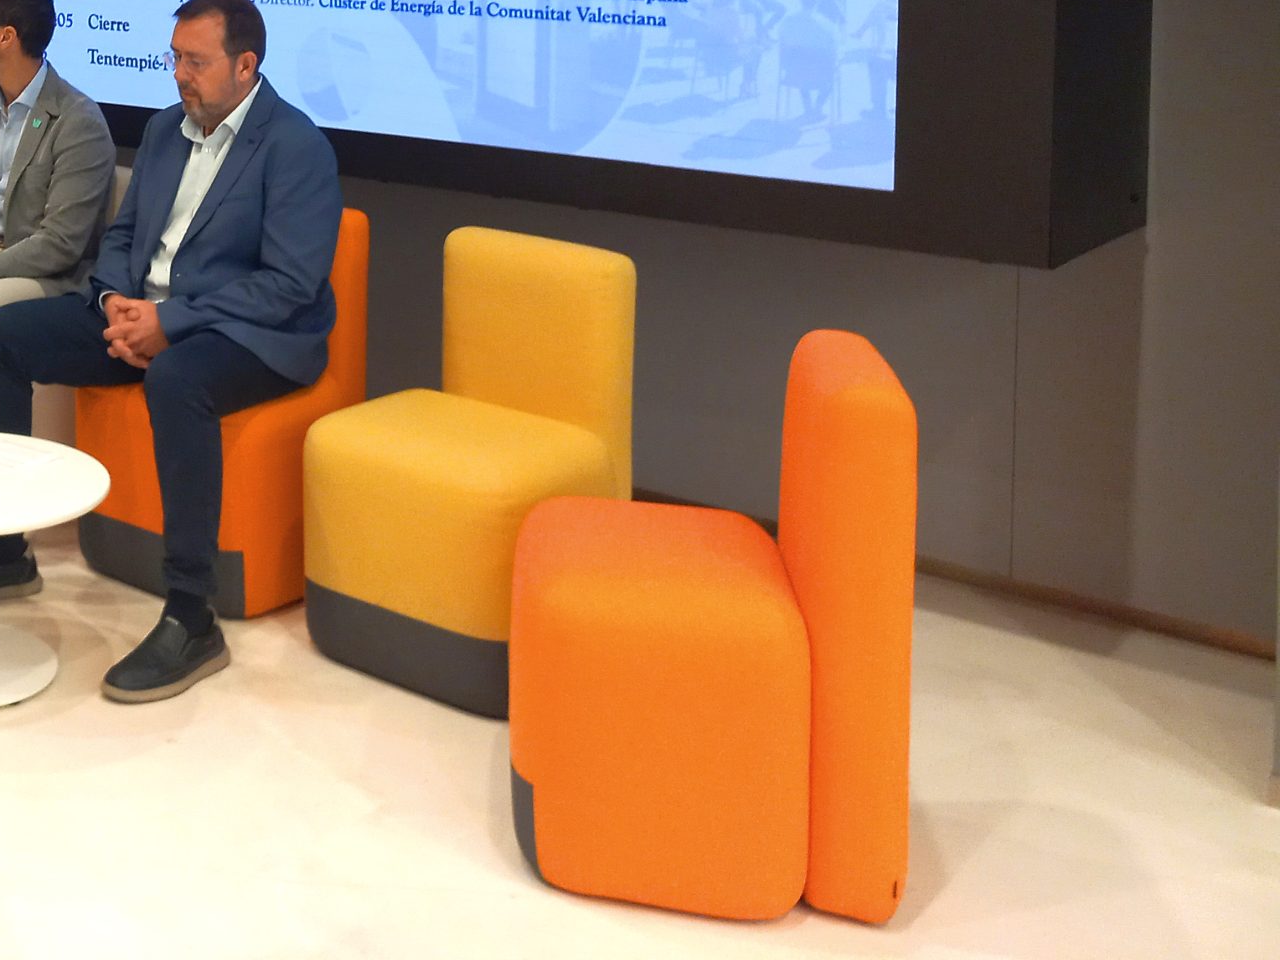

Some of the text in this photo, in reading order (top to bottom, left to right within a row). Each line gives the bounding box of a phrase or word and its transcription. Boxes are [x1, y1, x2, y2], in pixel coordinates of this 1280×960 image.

[88, 13, 130, 32] Cierre
[447, 0, 466, 15] de
[469, 0, 483, 17] la
[485, 2, 572, 21] Comunitat
[575, 6, 667, 27] Valenciana
